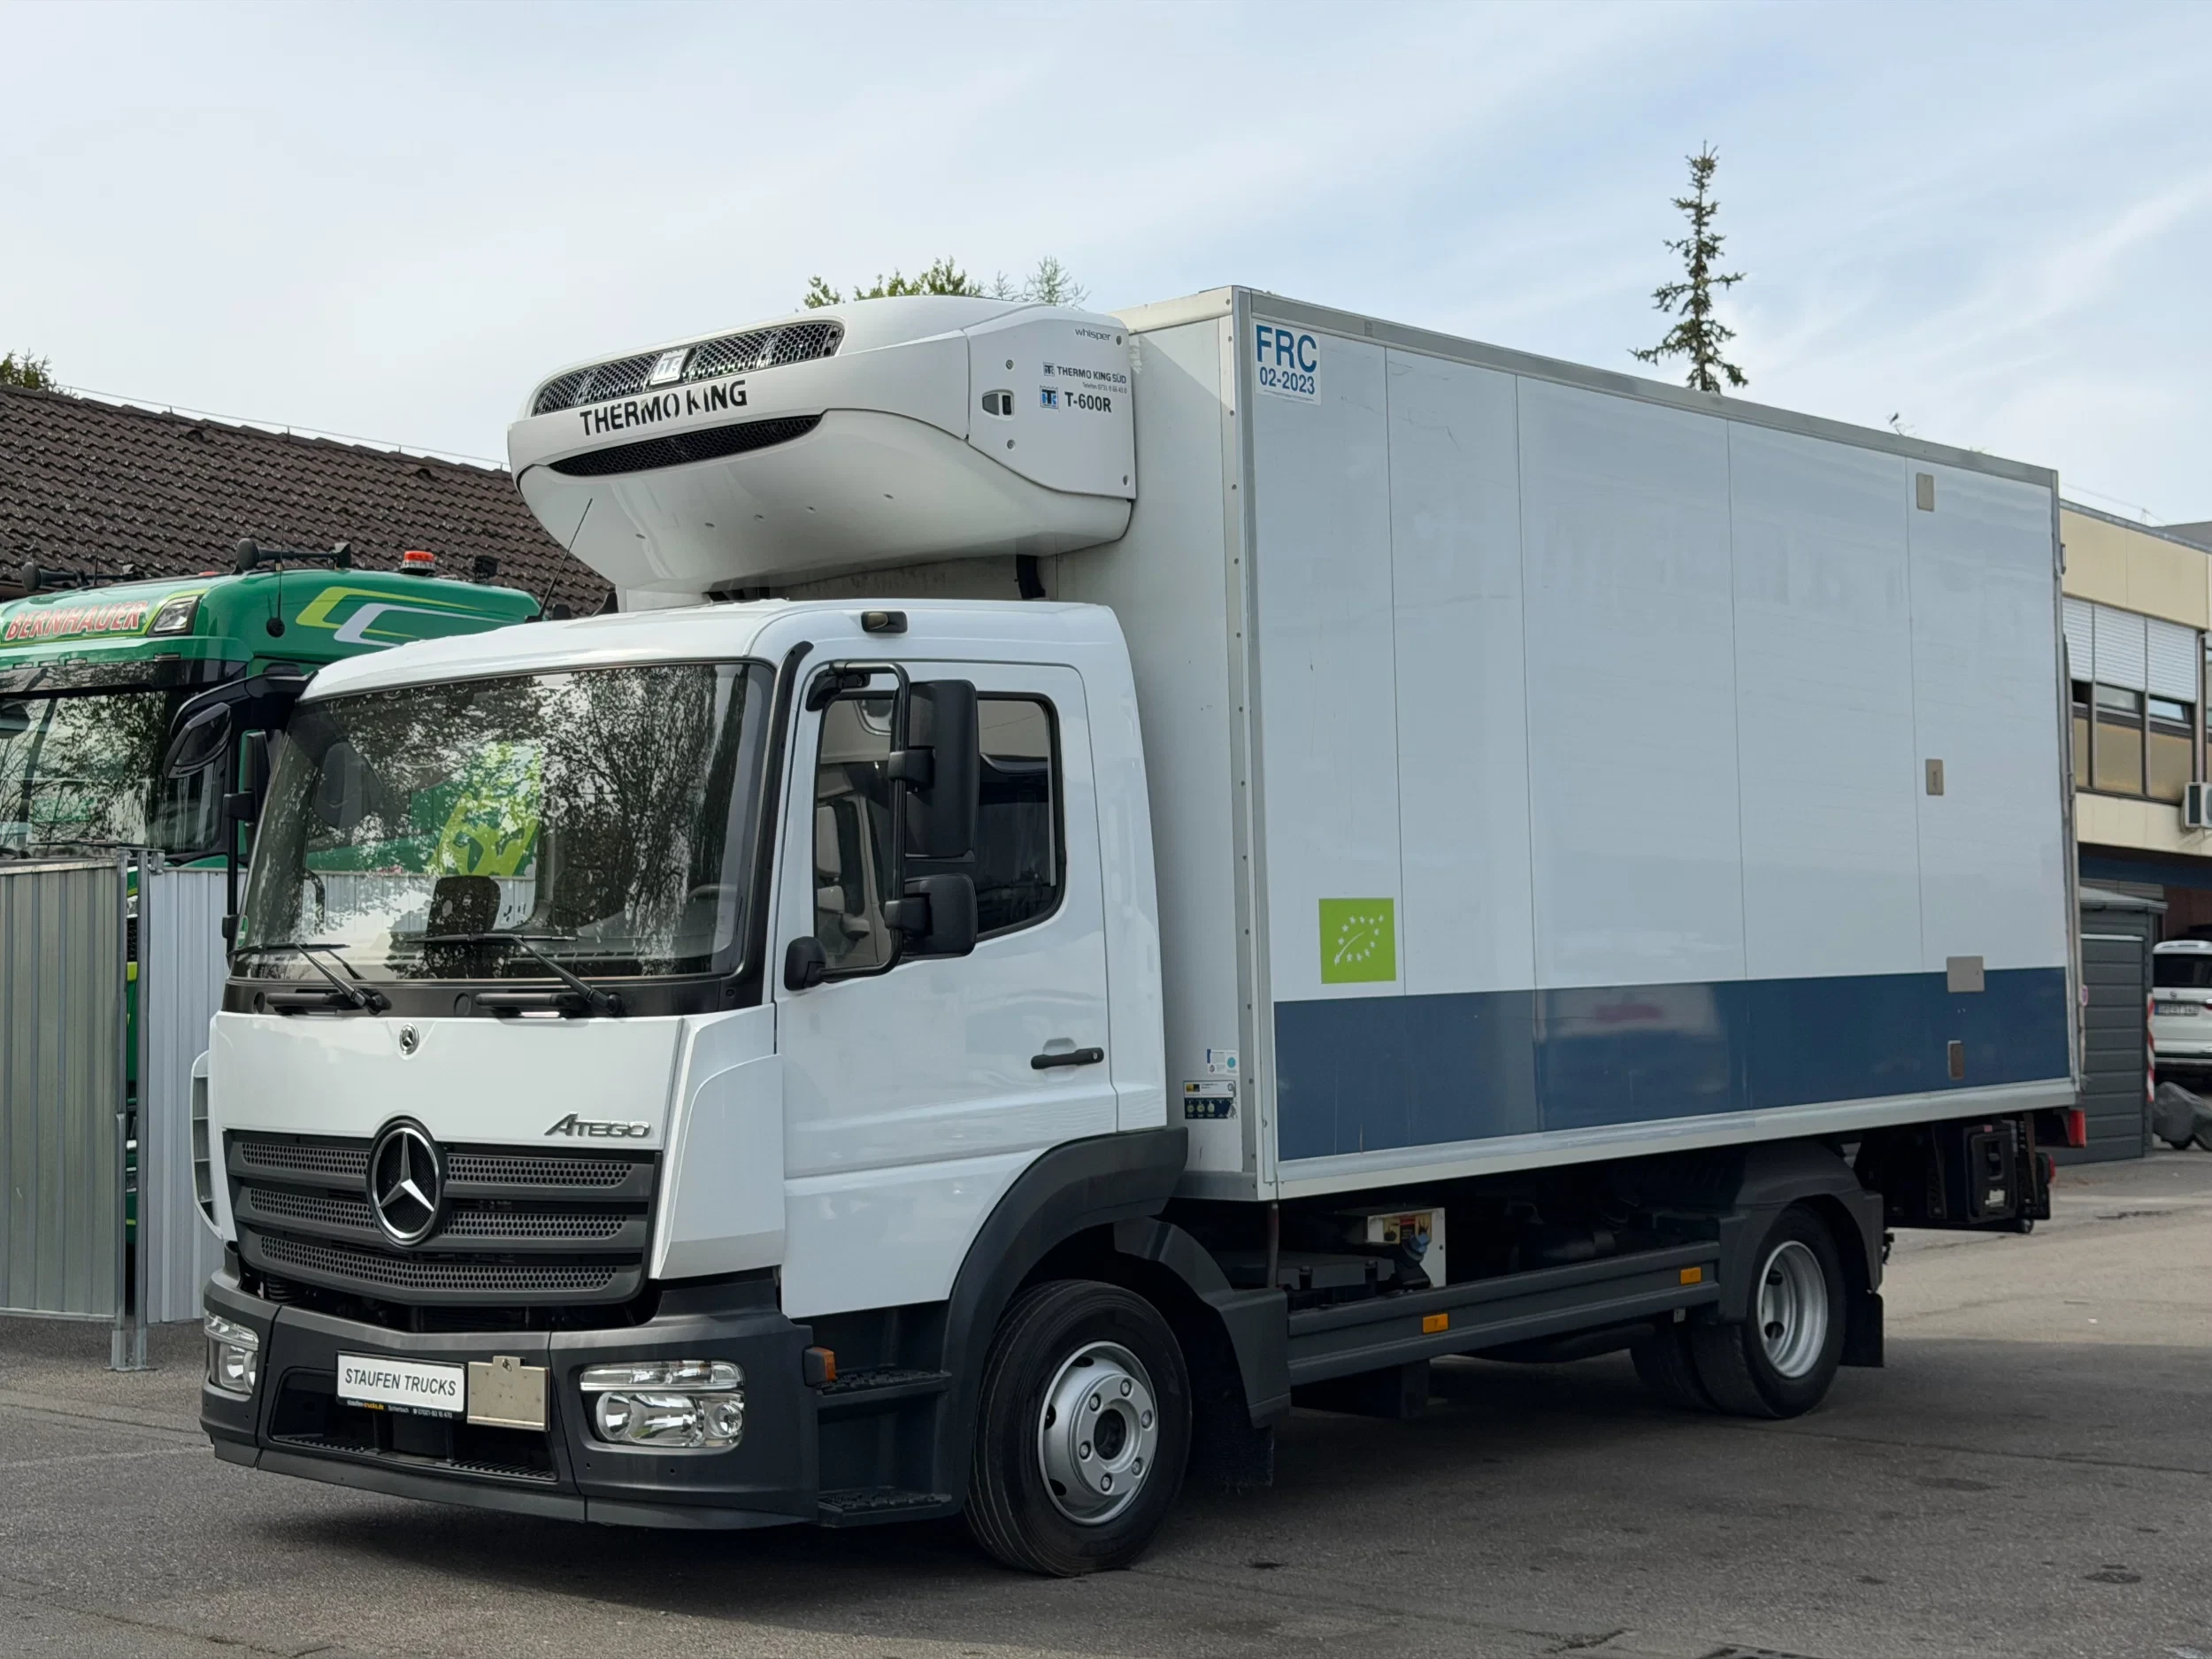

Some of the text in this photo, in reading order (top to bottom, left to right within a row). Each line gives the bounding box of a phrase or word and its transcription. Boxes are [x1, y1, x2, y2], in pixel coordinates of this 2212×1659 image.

[1075, 328, 1111, 341] whisper
[1256, 324, 1317, 373] FRC
[1056, 365, 1092, 380] THERMO
[1093, 370, 1111, 382] KING
[1112, 373, 1126, 384] SÜD
[1260, 366, 1315, 395] 02-2023
[580, 379, 748, 436] THERMO KING
[1064, 391, 1112, 413] T-600R
[4, 602, 149, 641] BERNHAUER
[345, 1368, 457, 1396] STAUFEN TRUCKS
